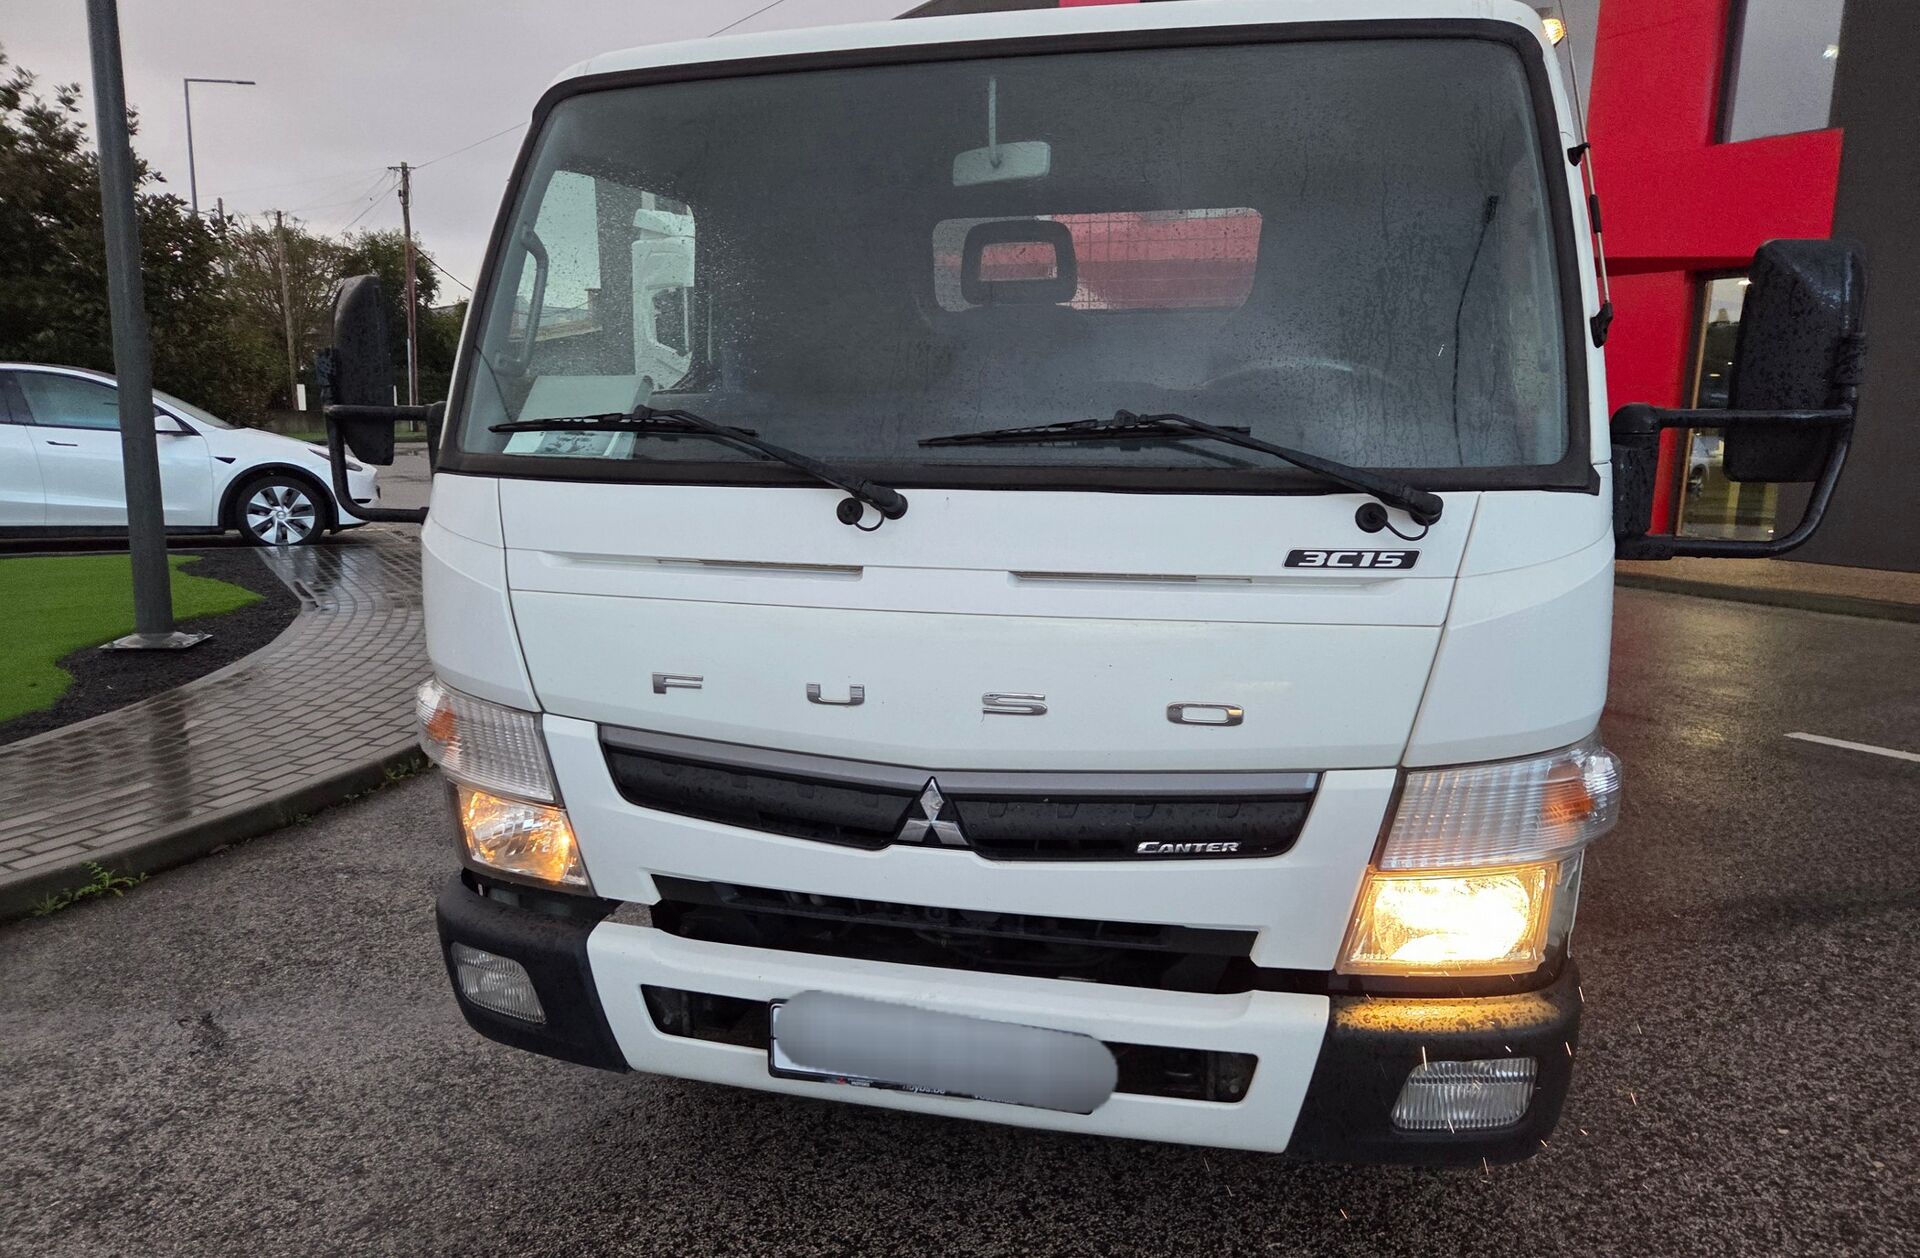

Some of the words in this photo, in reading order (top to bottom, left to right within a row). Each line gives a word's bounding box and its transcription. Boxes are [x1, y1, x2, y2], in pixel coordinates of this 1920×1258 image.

[1297, 551, 1406, 567] 3C15
[652, 671, 1245, 727] FUSO
[1136, 841, 1241, 854] CANTER
